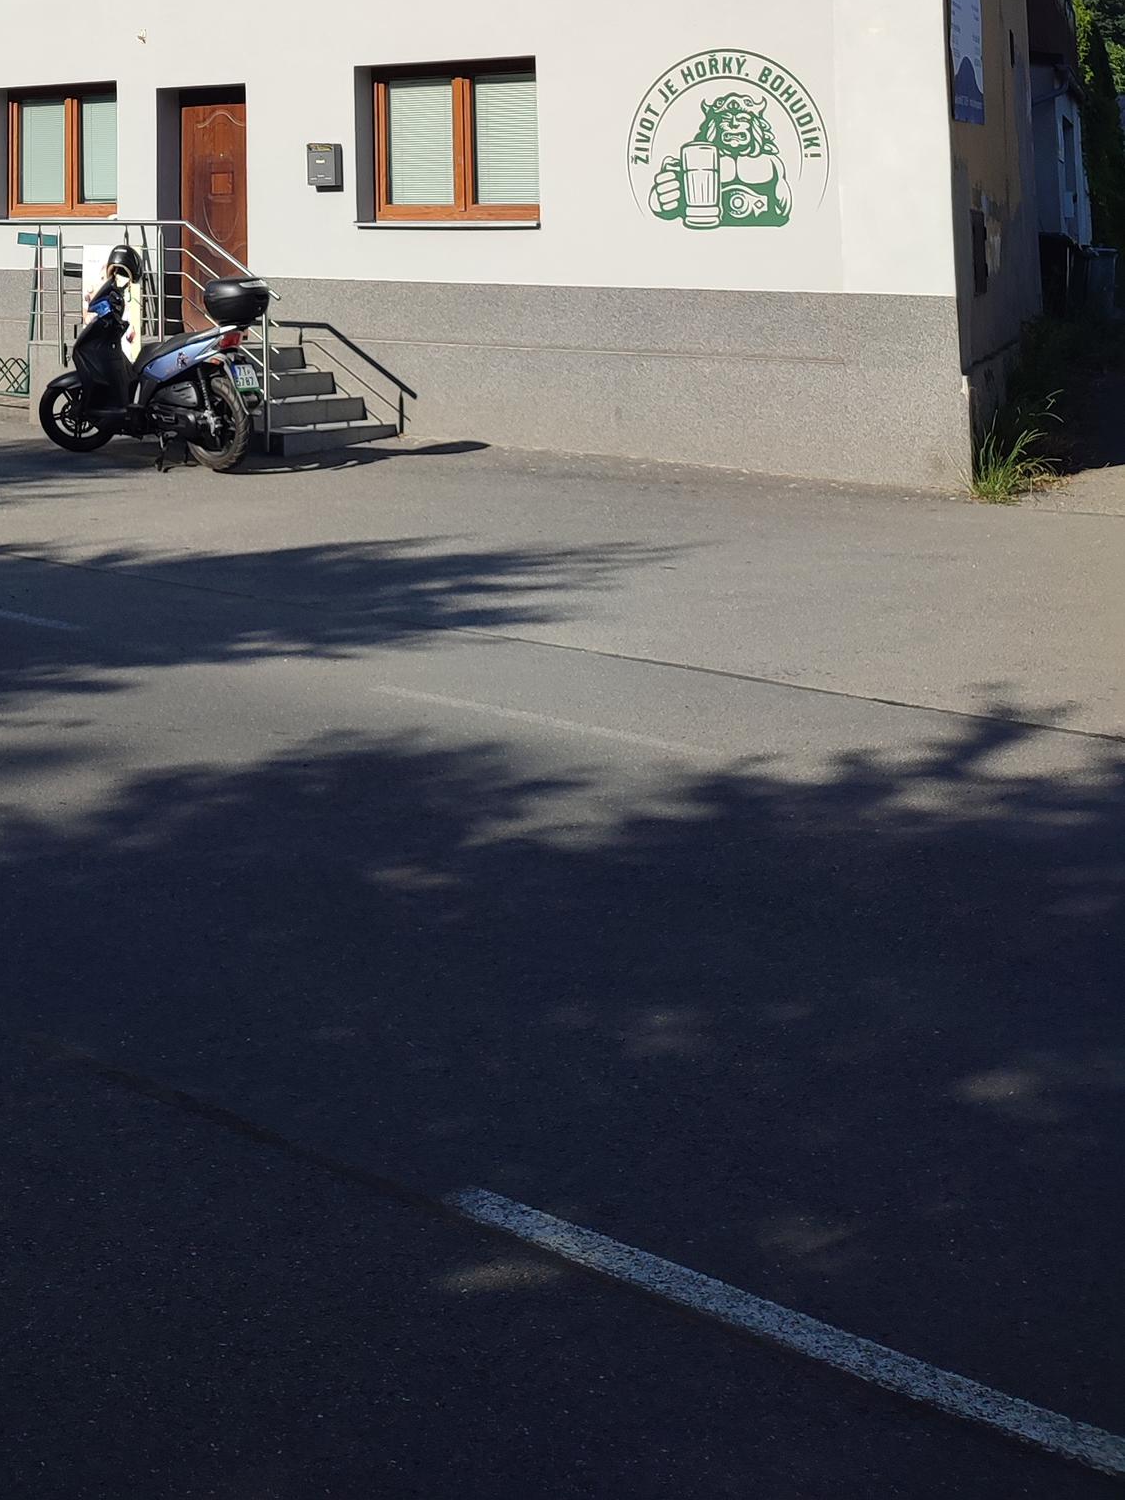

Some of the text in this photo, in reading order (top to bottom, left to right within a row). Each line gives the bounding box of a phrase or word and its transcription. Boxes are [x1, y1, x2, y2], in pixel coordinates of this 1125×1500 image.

[630, 53, 822, 165] ŽIVOT JE HOŘKÝ. BOHUDÍK!
